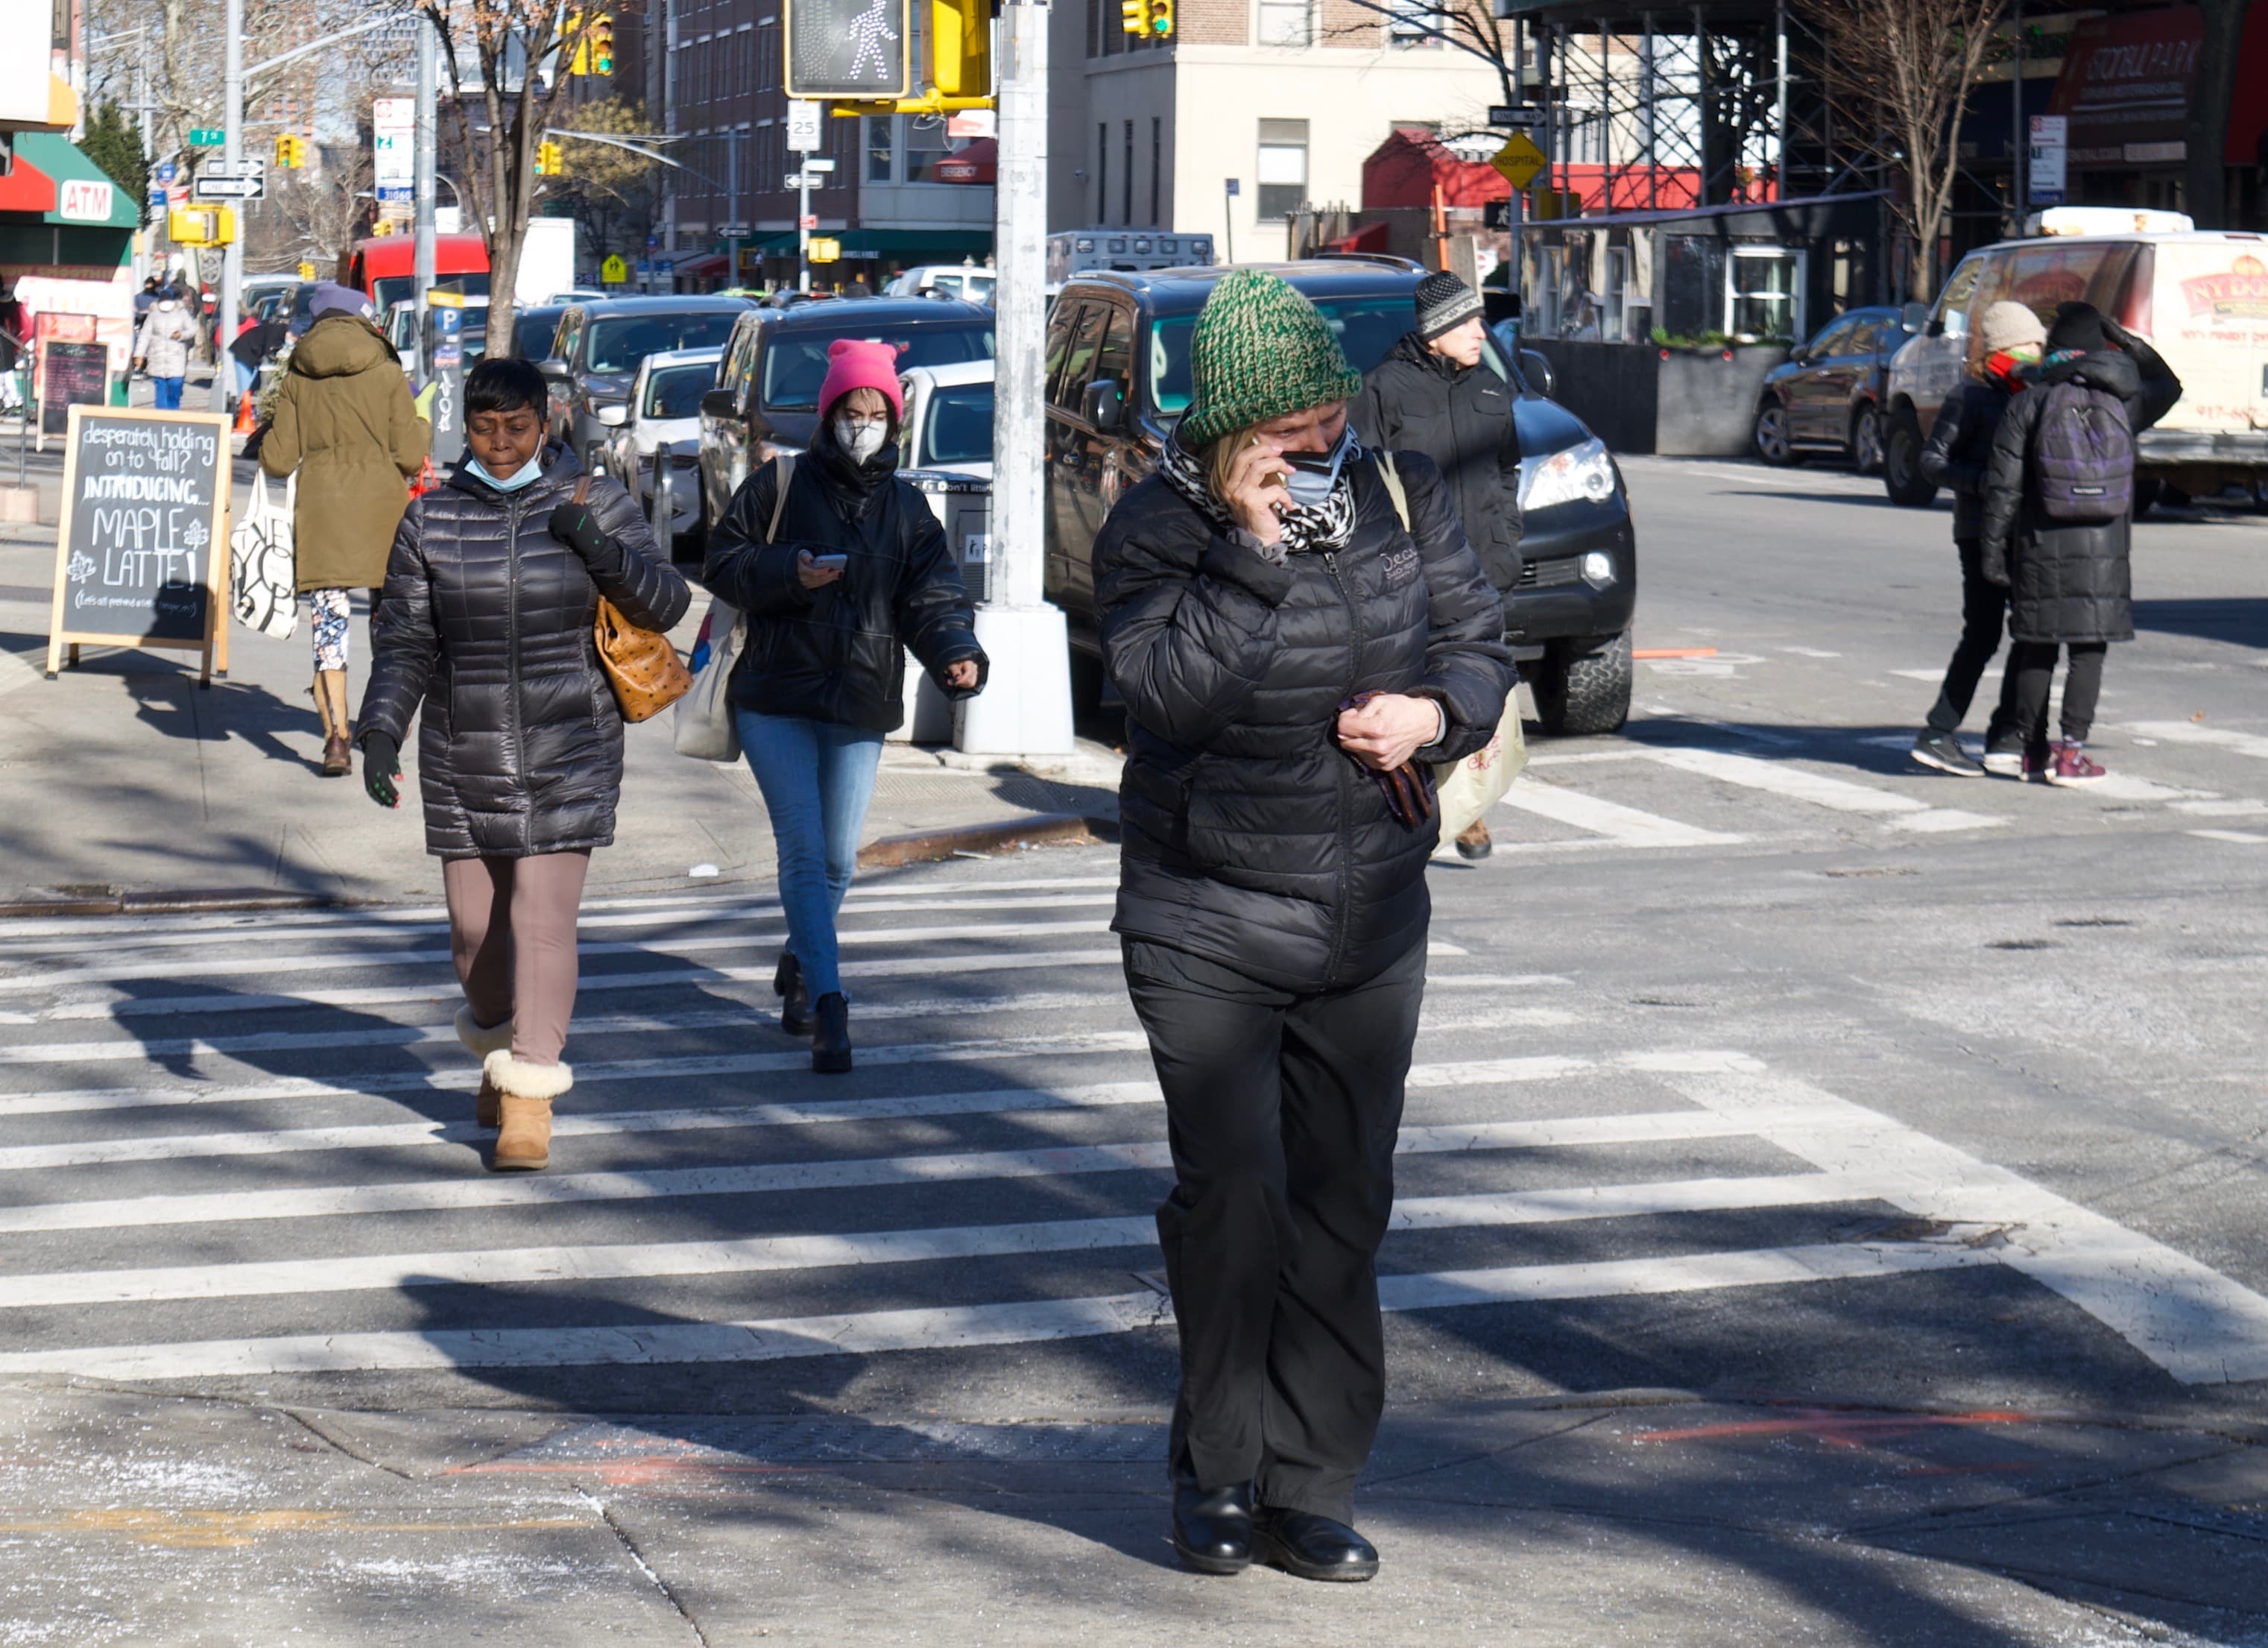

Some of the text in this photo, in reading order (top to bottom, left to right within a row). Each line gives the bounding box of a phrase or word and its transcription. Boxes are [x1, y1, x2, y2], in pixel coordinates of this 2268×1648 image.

[794, 121, 815, 134] 25
[1523, 113, 1542, 121] WAY
[1496, 156, 1540, 166] HOSPITAL
[66, 185, 107, 215] ATM
[443, 309, 458, 330] P
[83, 420, 215, 466] desperately holding
[105, 449, 192, 474] on to fall?
[92, 508, 186, 555] MAPLE
[103, 547, 197, 591] LATTE!
